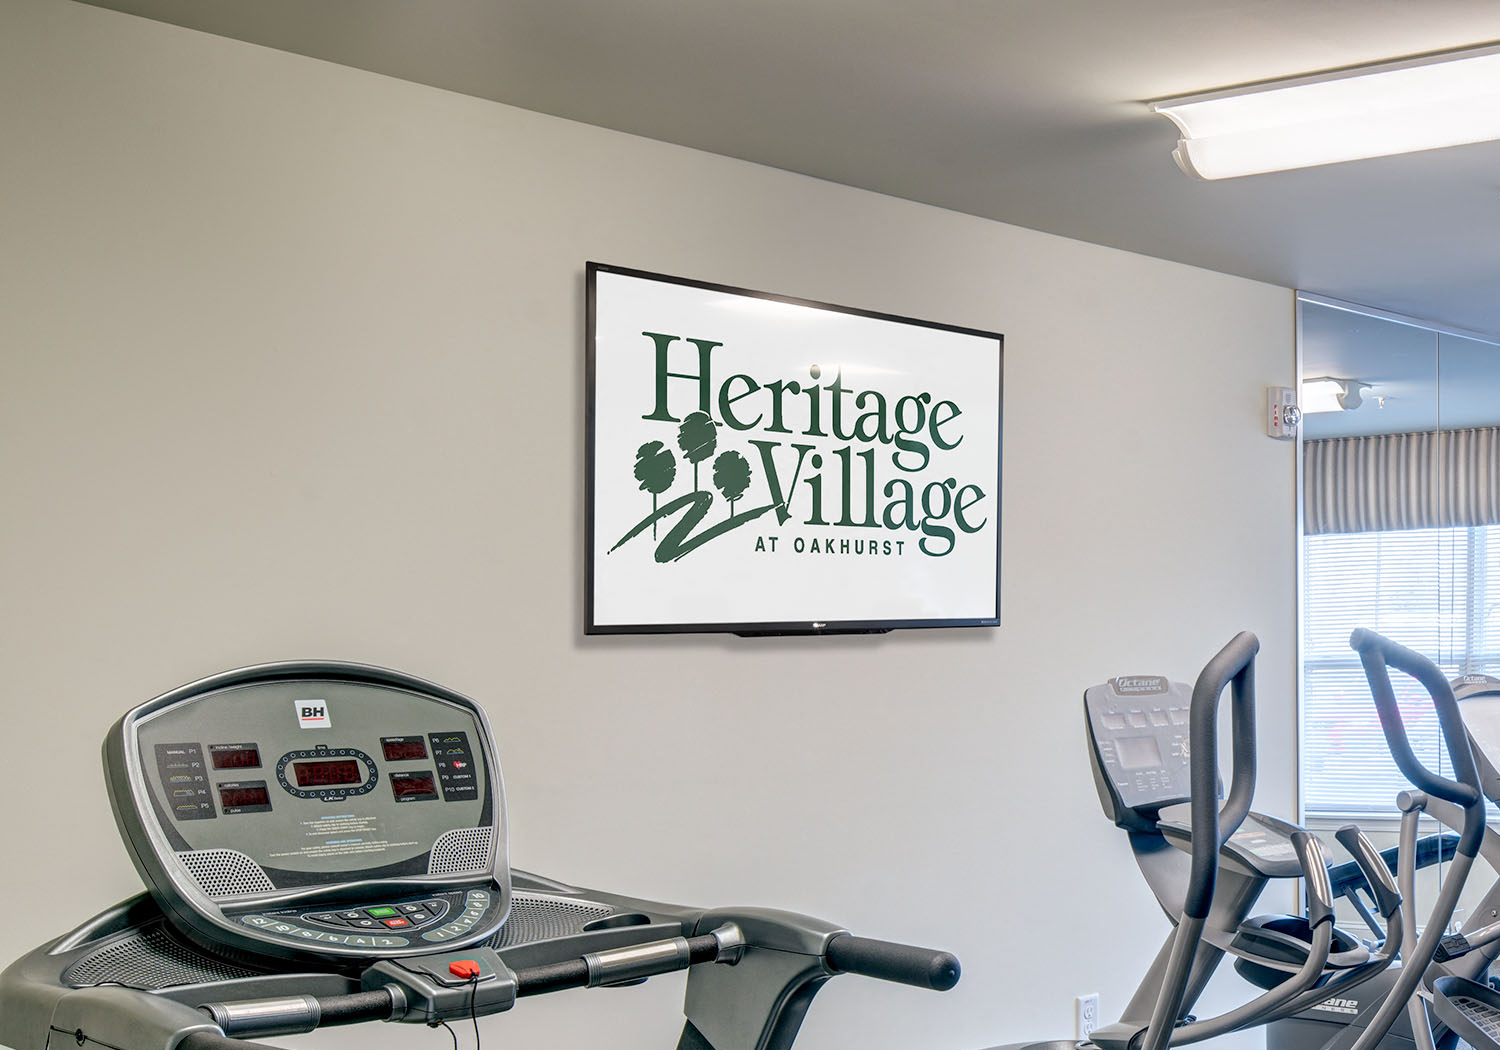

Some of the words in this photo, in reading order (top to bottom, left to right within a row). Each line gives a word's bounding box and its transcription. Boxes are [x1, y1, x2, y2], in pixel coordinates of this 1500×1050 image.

[641, 331, 964, 472] Heritage
[748, 439, 987, 557] Village
[755, 536, 778, 552] AT
[794, 537, 905, 556] OAKHURST
[301, 707, 325, 717] BH
[1321, 998, 1358, 1008] ane
